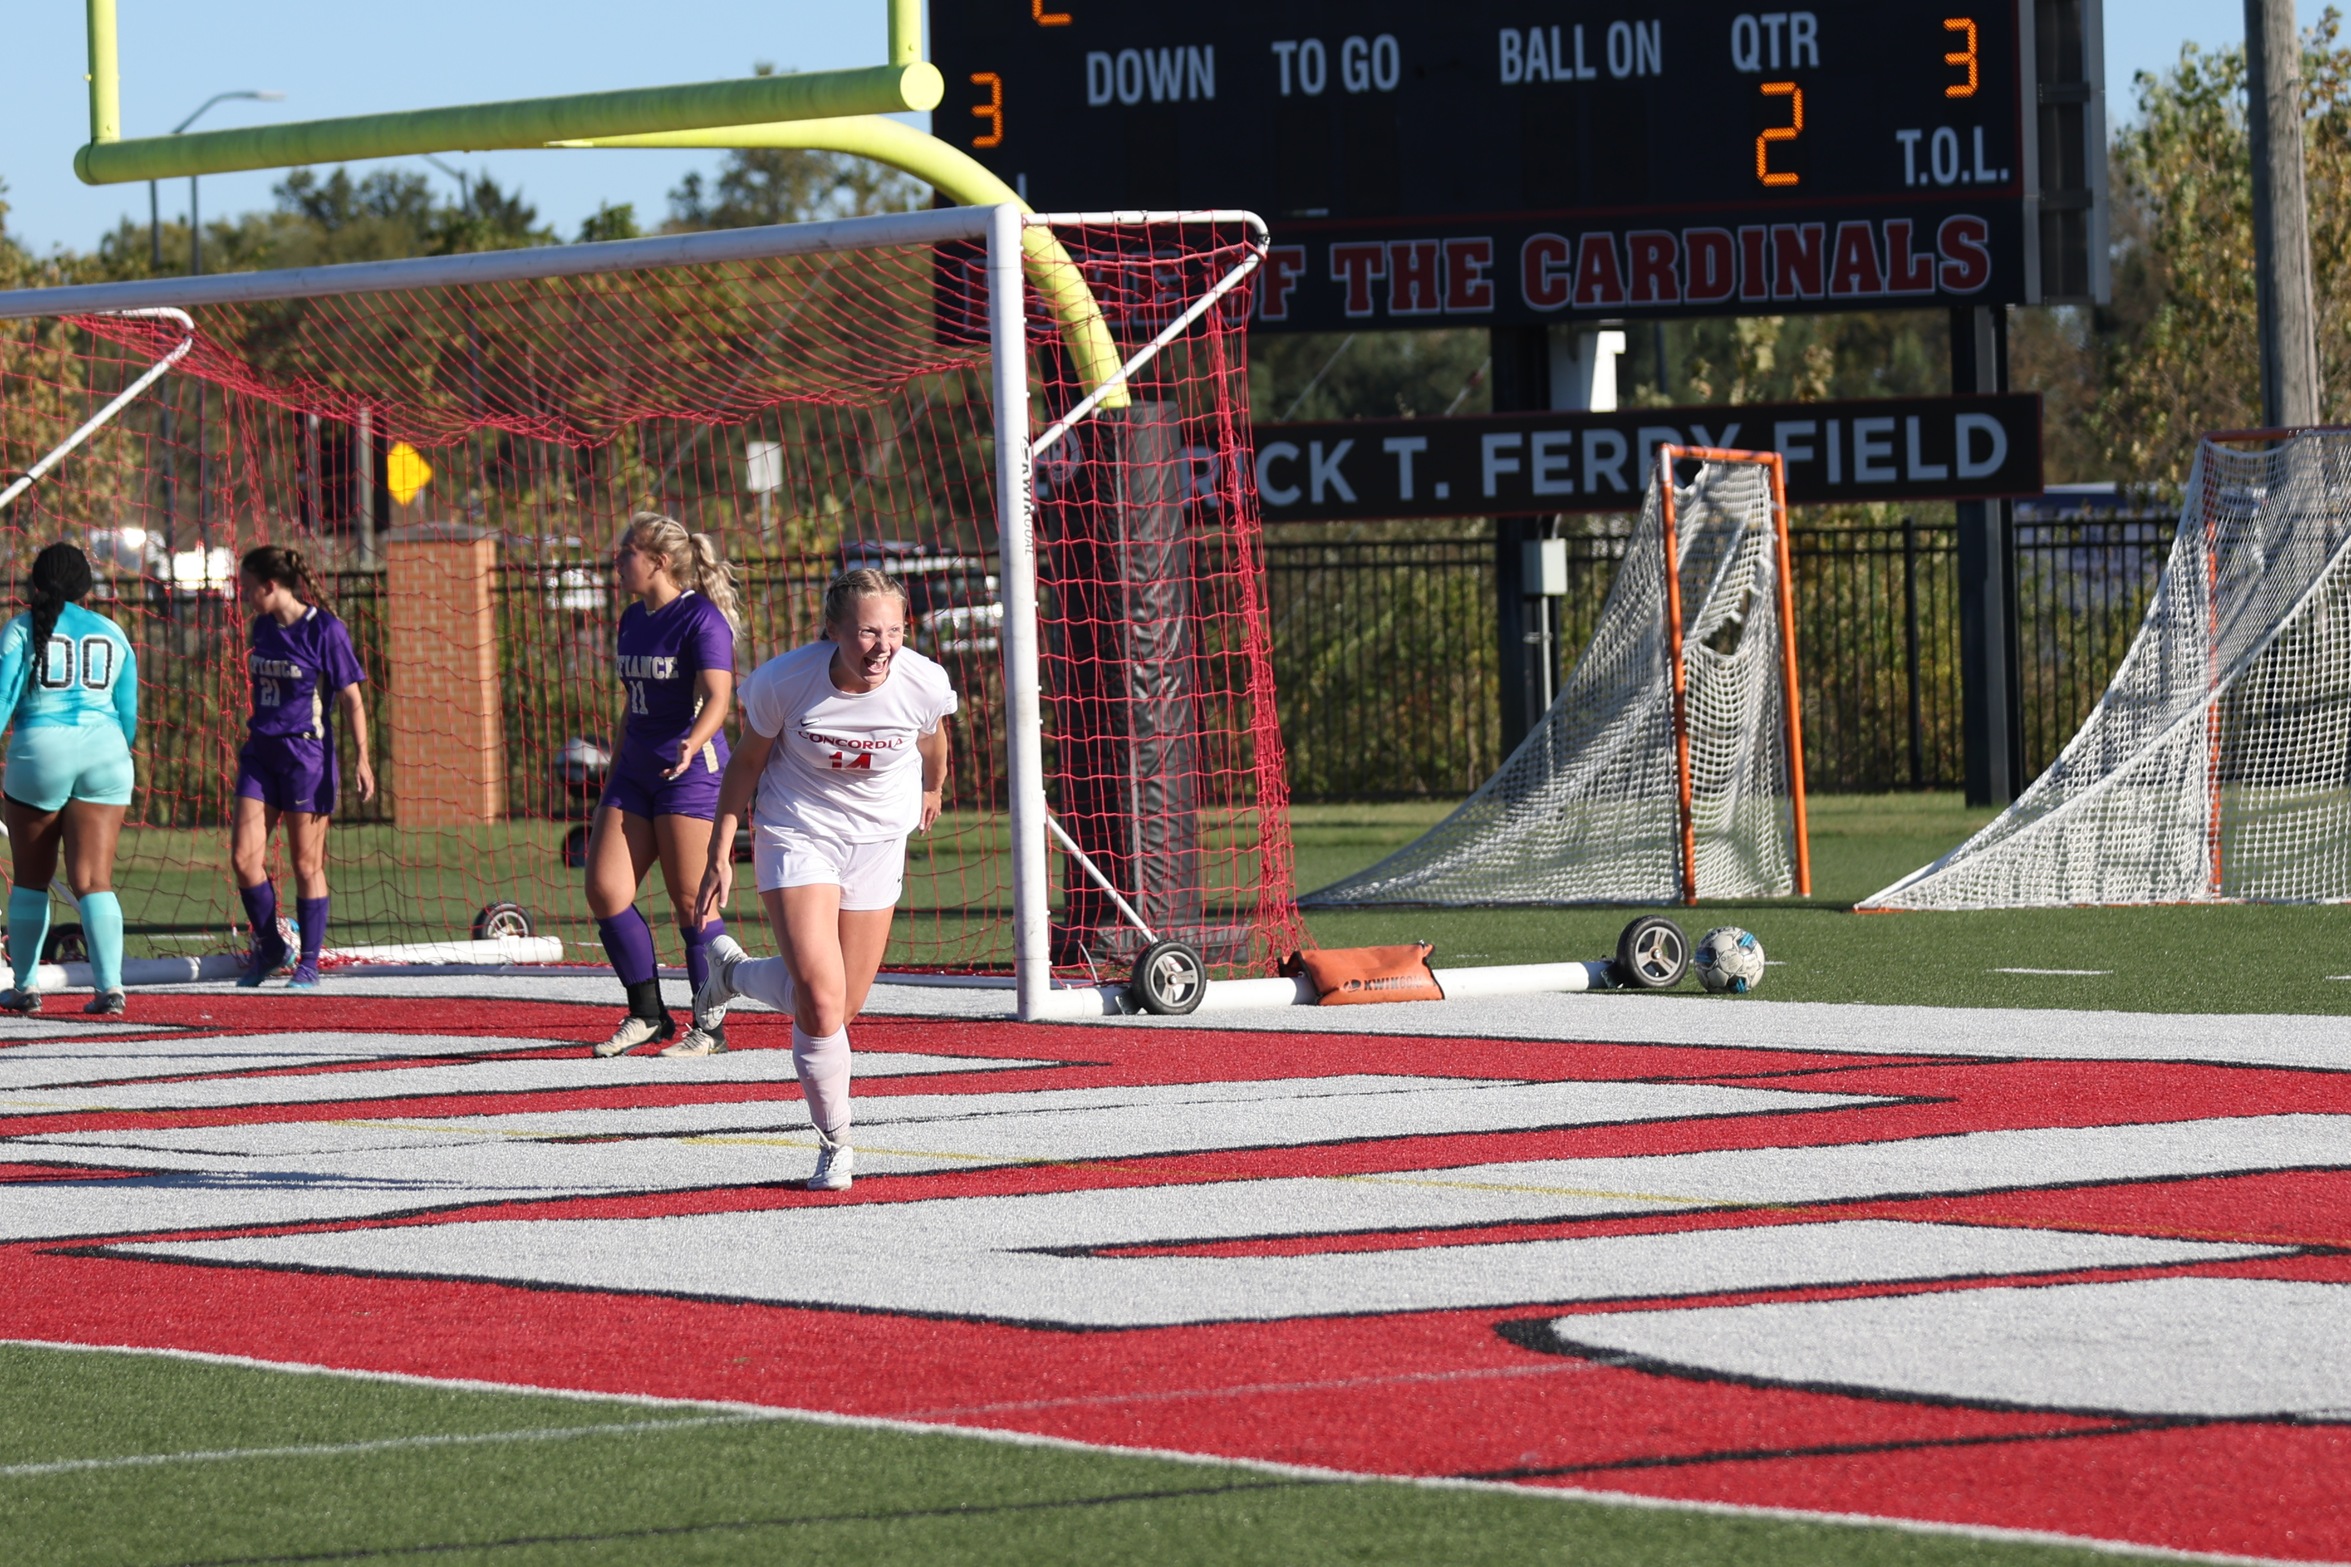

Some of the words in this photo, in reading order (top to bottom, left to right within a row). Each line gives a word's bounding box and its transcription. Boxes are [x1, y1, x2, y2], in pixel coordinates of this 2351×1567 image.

[1272, 39, 1327, 95] TO
[1341, 34, 1401, 91] GO
[1499, 24, 1596, 84] BALL
[1606, 19, 1662, 78] ON
[1730, 11, 1819, 72] QTR
[1943, 17, 1978, 98] 3
[1086, 45, 1216, 106] DOWN
[970, 71, 1003, 148] 3
[1755, 81, 1803, 187] 2
[1896, 126, 2009, 185] T.O.L.
[1330, 237, 1494, 318] THE
[1520, 214, 1991, 312] CARDINALS
[1382, 436, 1450, 500] T.
[1774, 412, 2008, 486] FIELD
[40, 632, 113, 691] 00
[259, 677, 281, 707] 21
[629, 680, 649, 715] 11
[797, 730, 904, 750] CONCORDIA
[828, 750, 873, 770] 14
